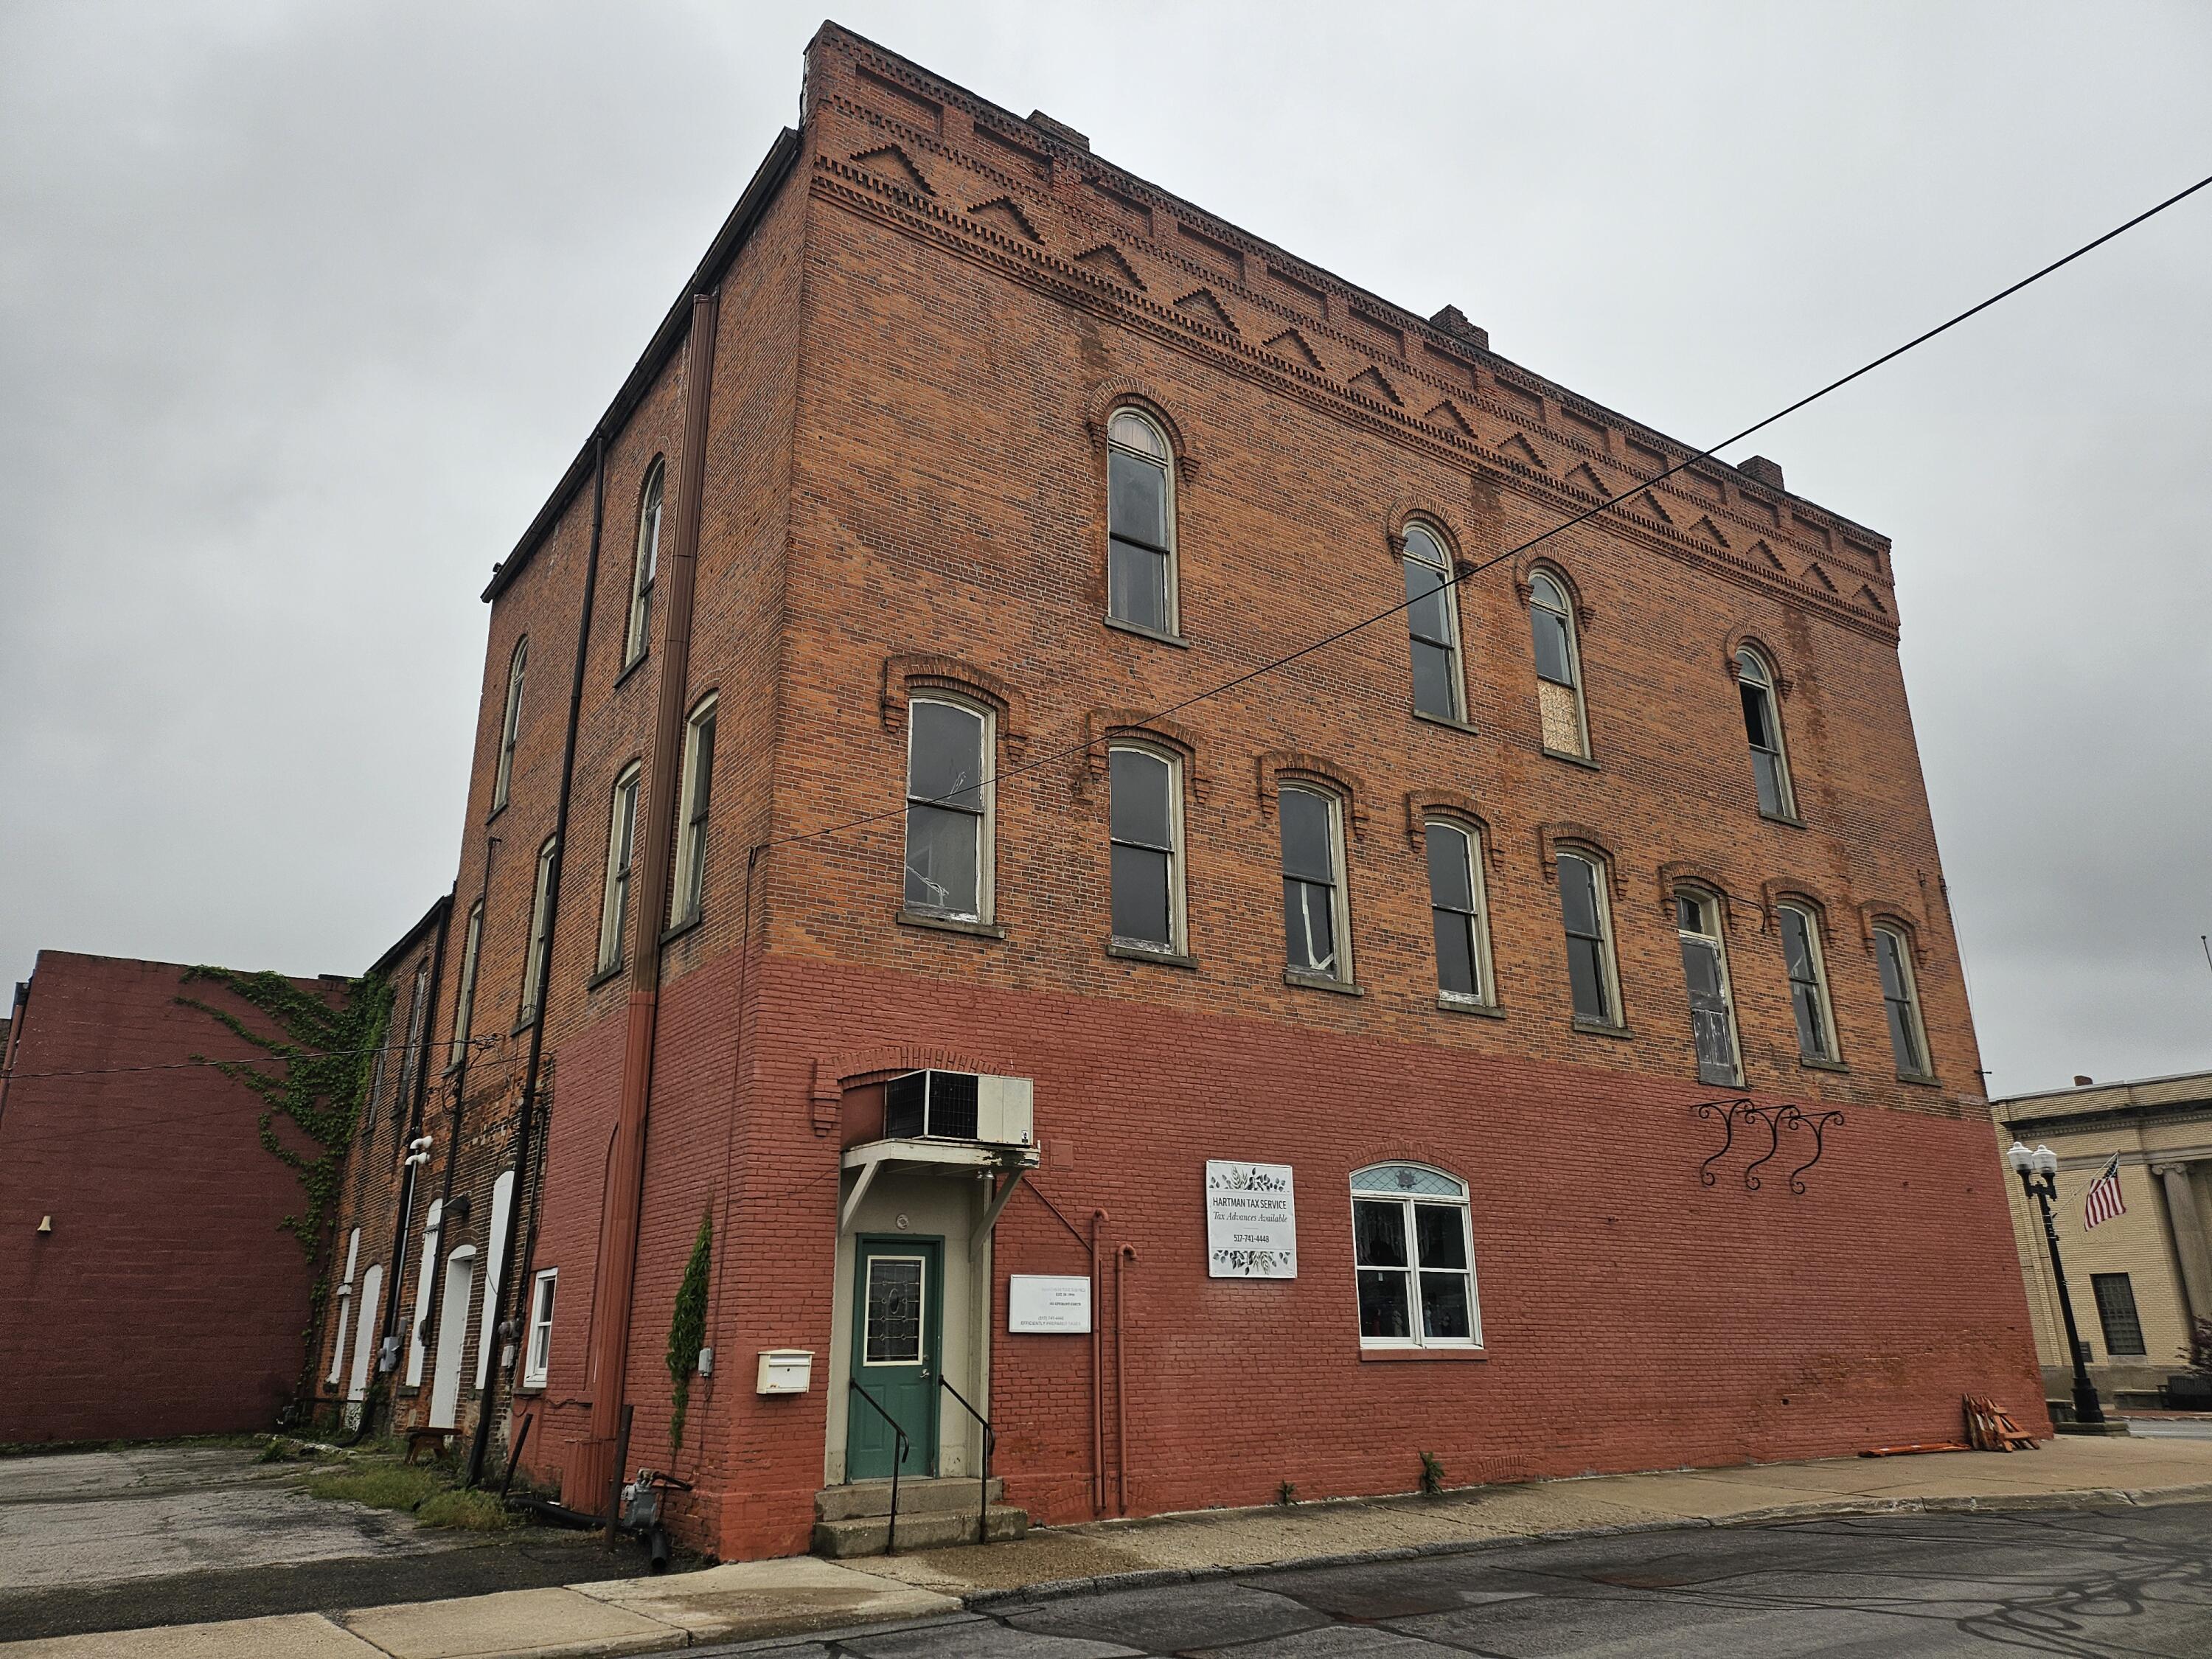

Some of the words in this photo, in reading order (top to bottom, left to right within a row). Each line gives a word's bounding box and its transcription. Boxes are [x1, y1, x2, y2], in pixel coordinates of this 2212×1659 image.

[1213, 1197, 1245, 1208] HARTMAN
[1246, 1198, 1259, 1208] TAX
[1260, 1199, 1287, 1209] SERVICE
[1213, 1211, 1225, 1220] Tax
[1226, 1211, 1257, 1222] Advances
[1258, 1213, 1287, 1222] Available
[1234, 1234, 1270, 1243] 517-741-4448
